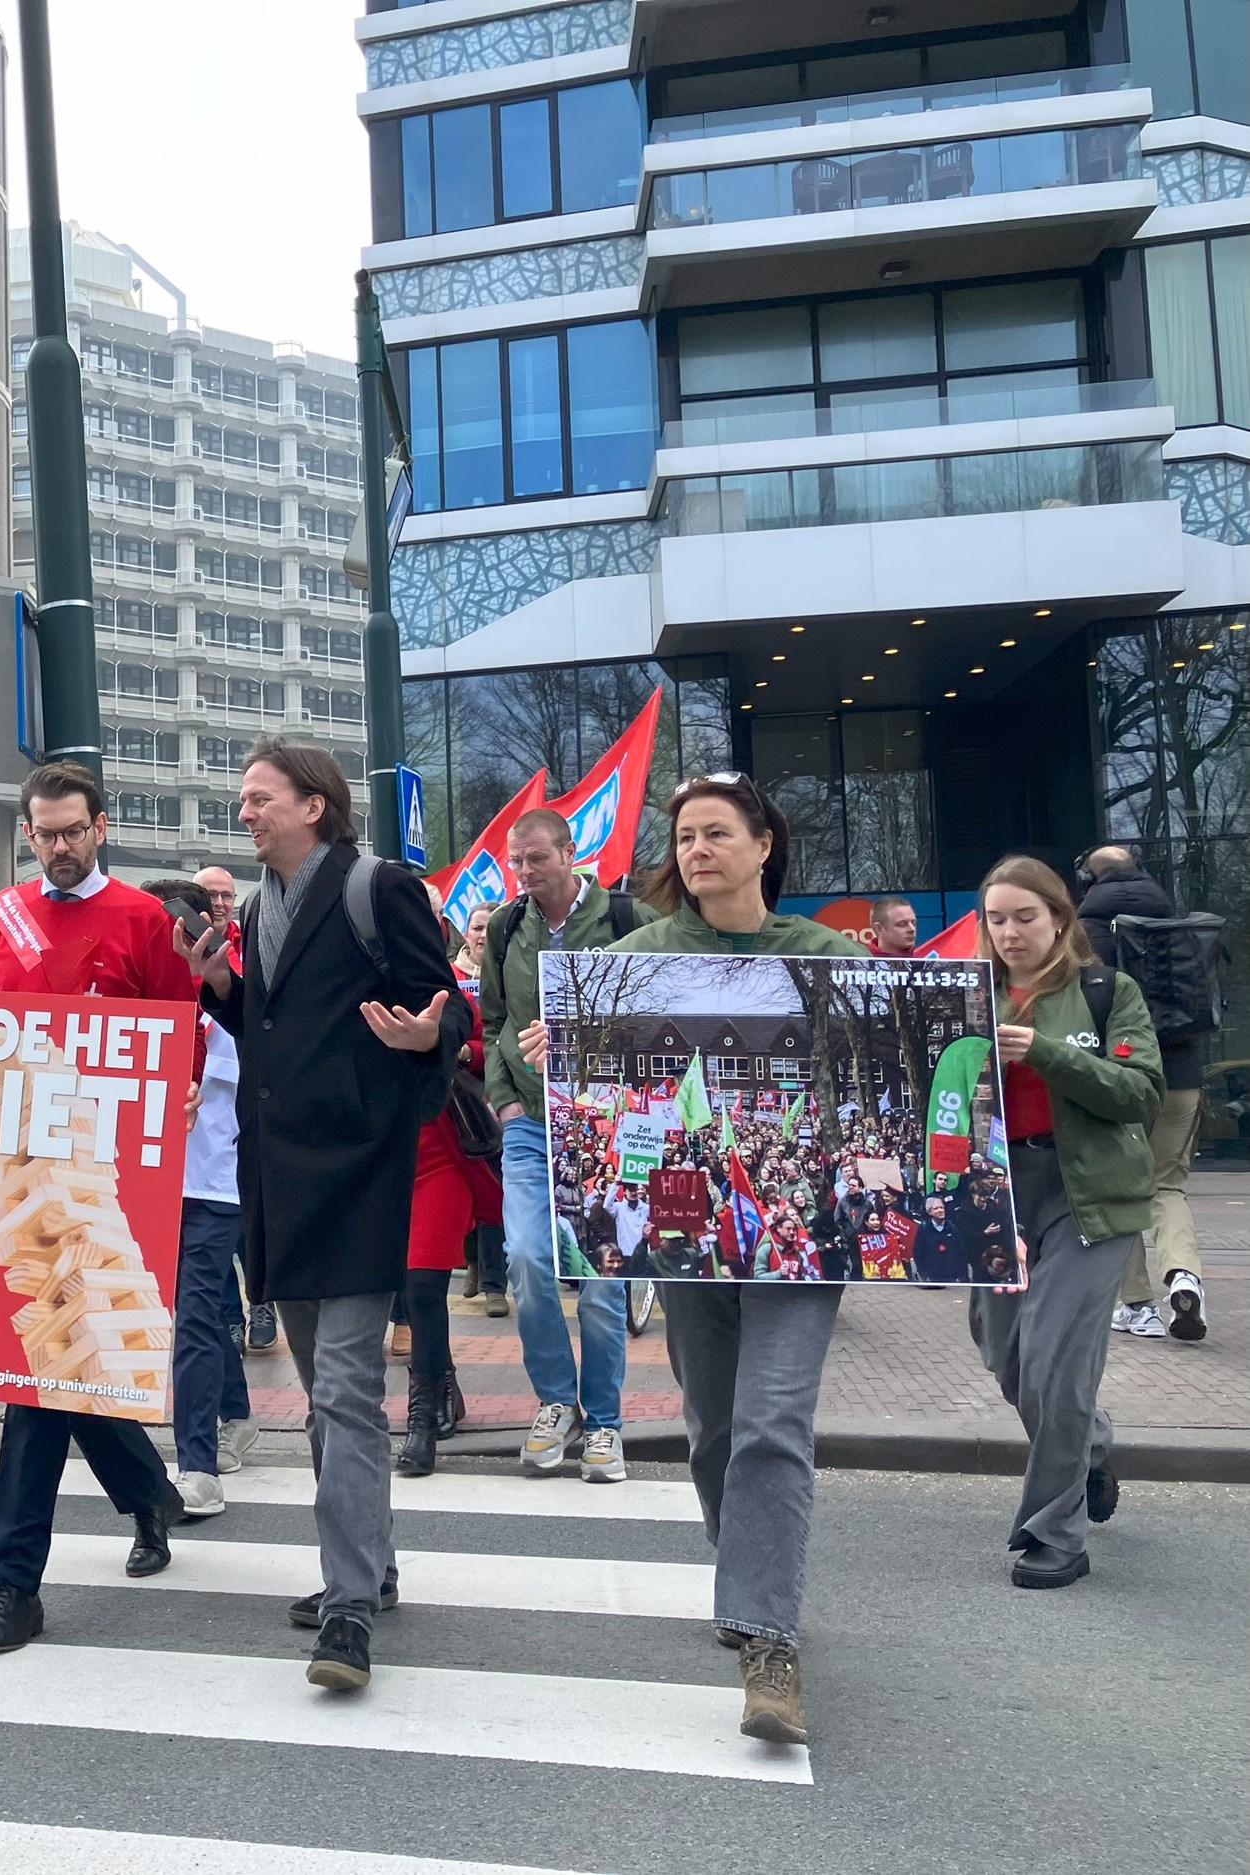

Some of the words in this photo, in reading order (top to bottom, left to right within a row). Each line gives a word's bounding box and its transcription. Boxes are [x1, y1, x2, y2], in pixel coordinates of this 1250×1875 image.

[831, 970, 909, 986] UTRECHT
[913, 972, 979, 987] 11-3-25
[63, 1013, 175, 1072] HET
[1066, 1032, 1100, 1048] AOb
[936, 1090, 962, 1136] 66
[637, 1124, 652, 1134] Zet
[622, 1132, 664, 1144] onderwijs
[627, 1141, 639, 1150] op
[41, 1378, 57, 1392] op
[58, 1378, 148, 1401] universiteiten.
